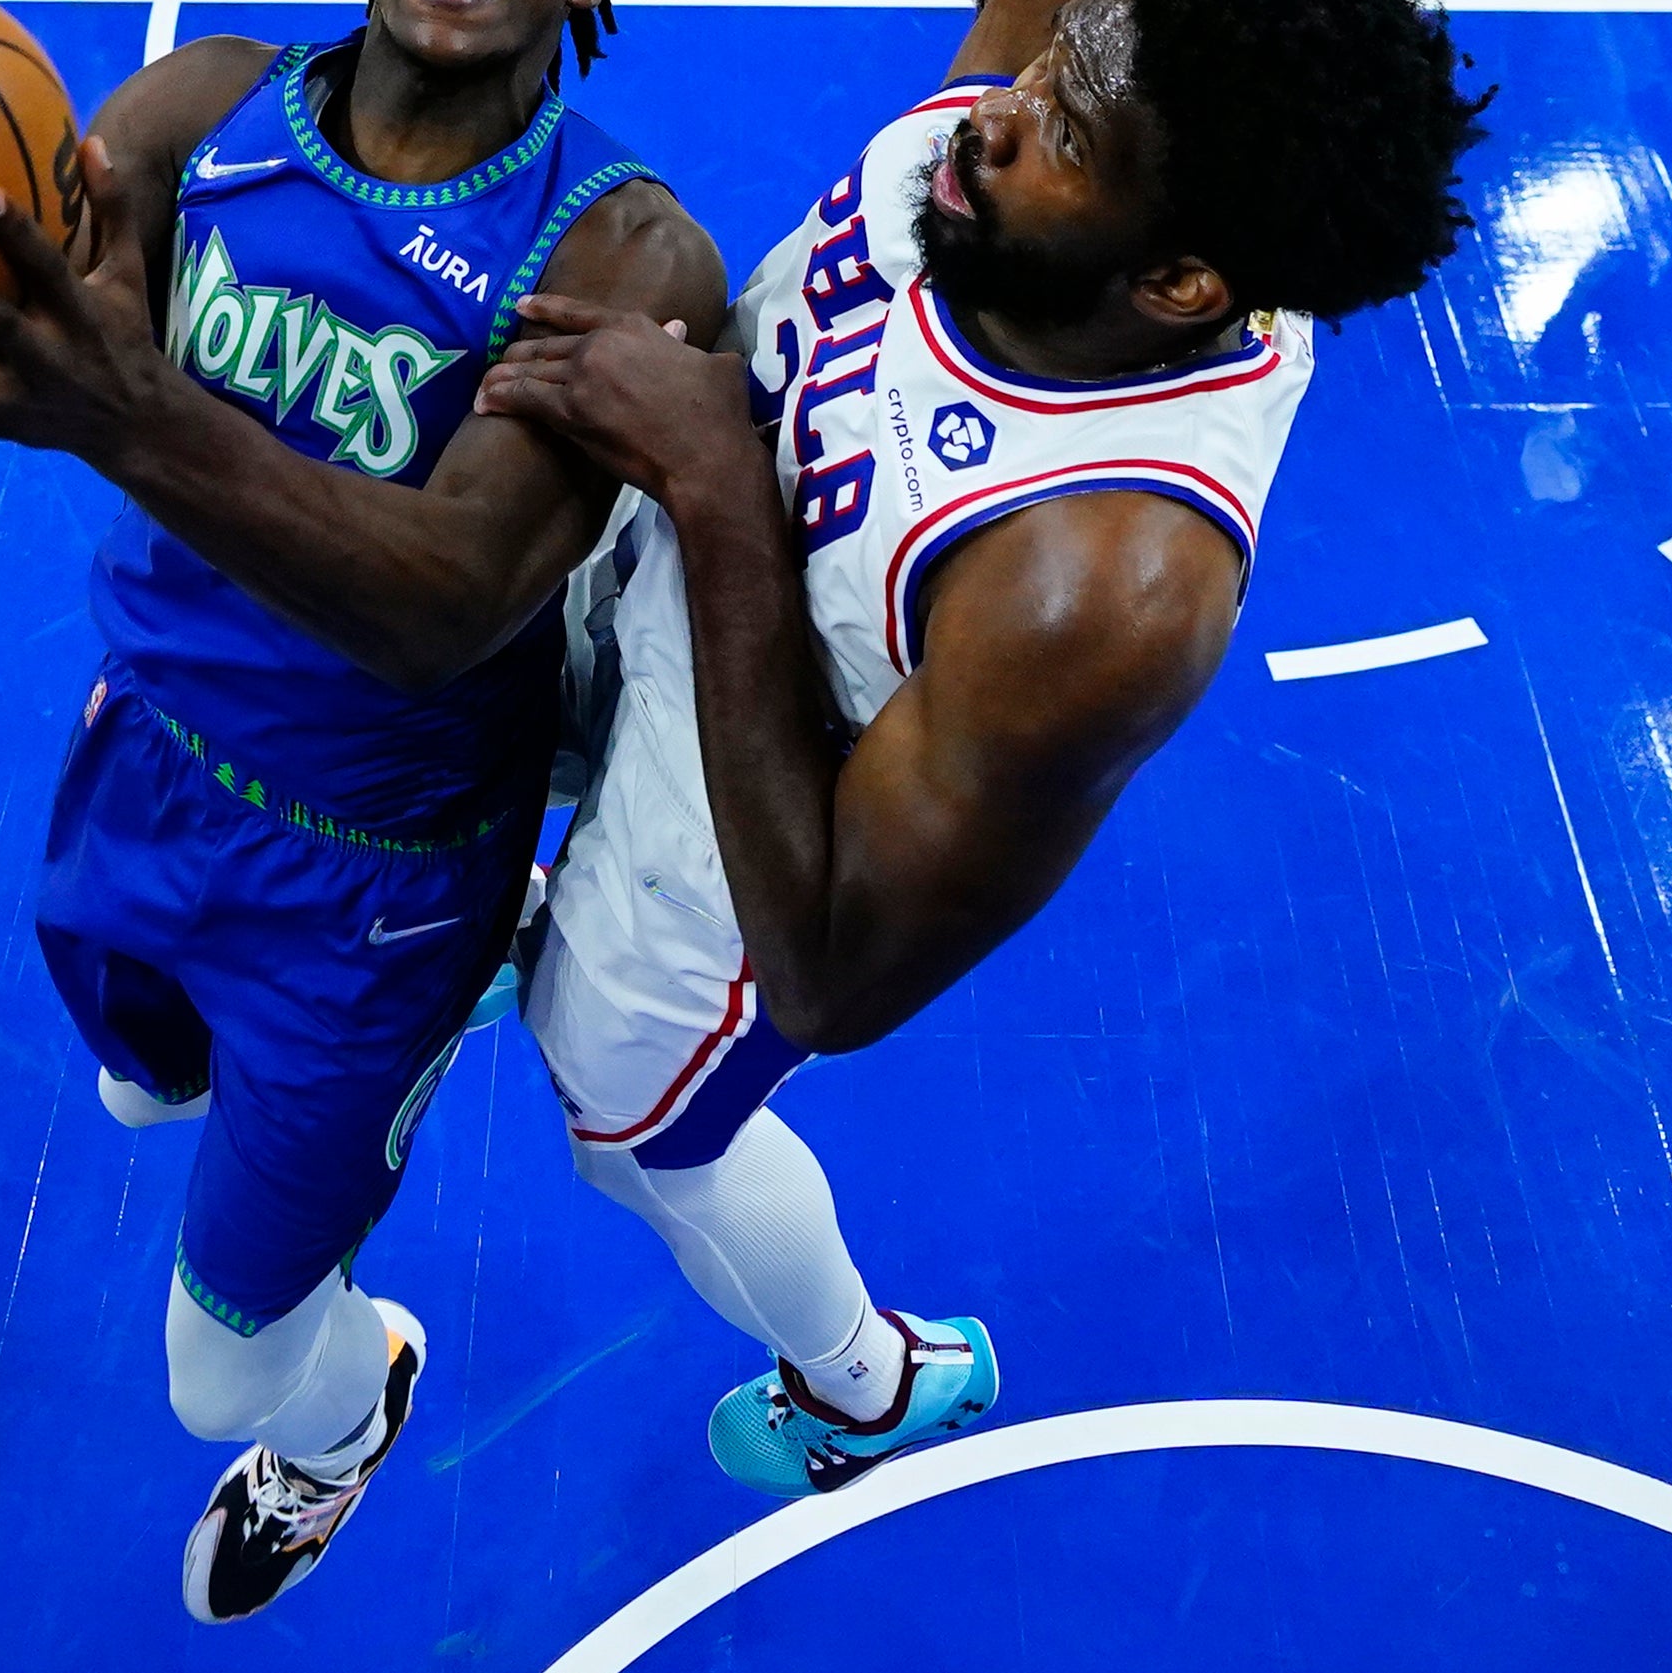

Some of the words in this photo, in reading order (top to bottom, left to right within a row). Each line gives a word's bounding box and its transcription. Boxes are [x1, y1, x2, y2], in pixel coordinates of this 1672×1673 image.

[165, 211, 468, 479] WOLVES
[792, 151, 896, 568] PHILA
[887, 387, 924, 513] crypto.com
